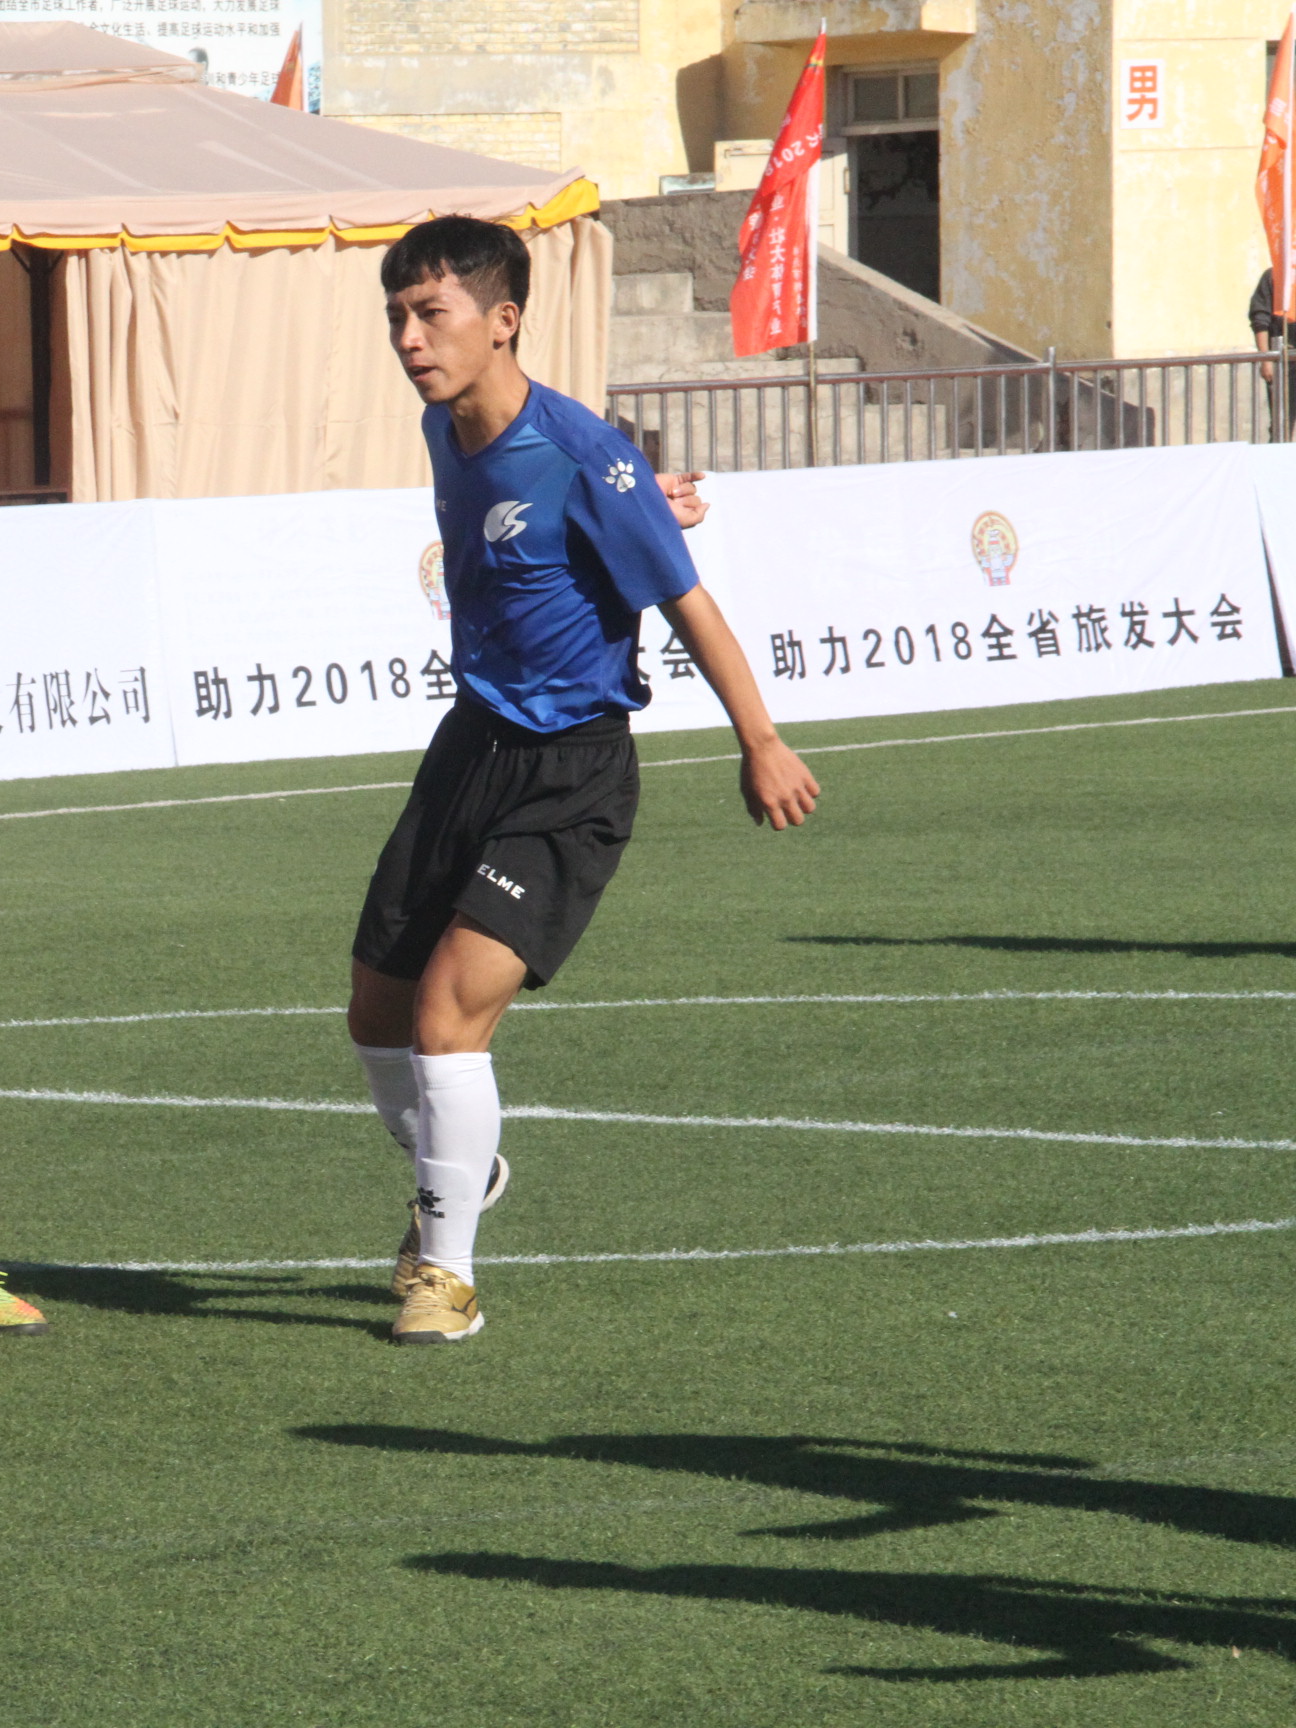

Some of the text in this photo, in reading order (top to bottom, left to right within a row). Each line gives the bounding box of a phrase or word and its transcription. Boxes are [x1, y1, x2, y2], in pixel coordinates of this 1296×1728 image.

[1125, 66, 1157, 121] 男
[771, 592, 1245, 681] 助力2018全省旅发大会
[476, 863, 526, 900] ELME
